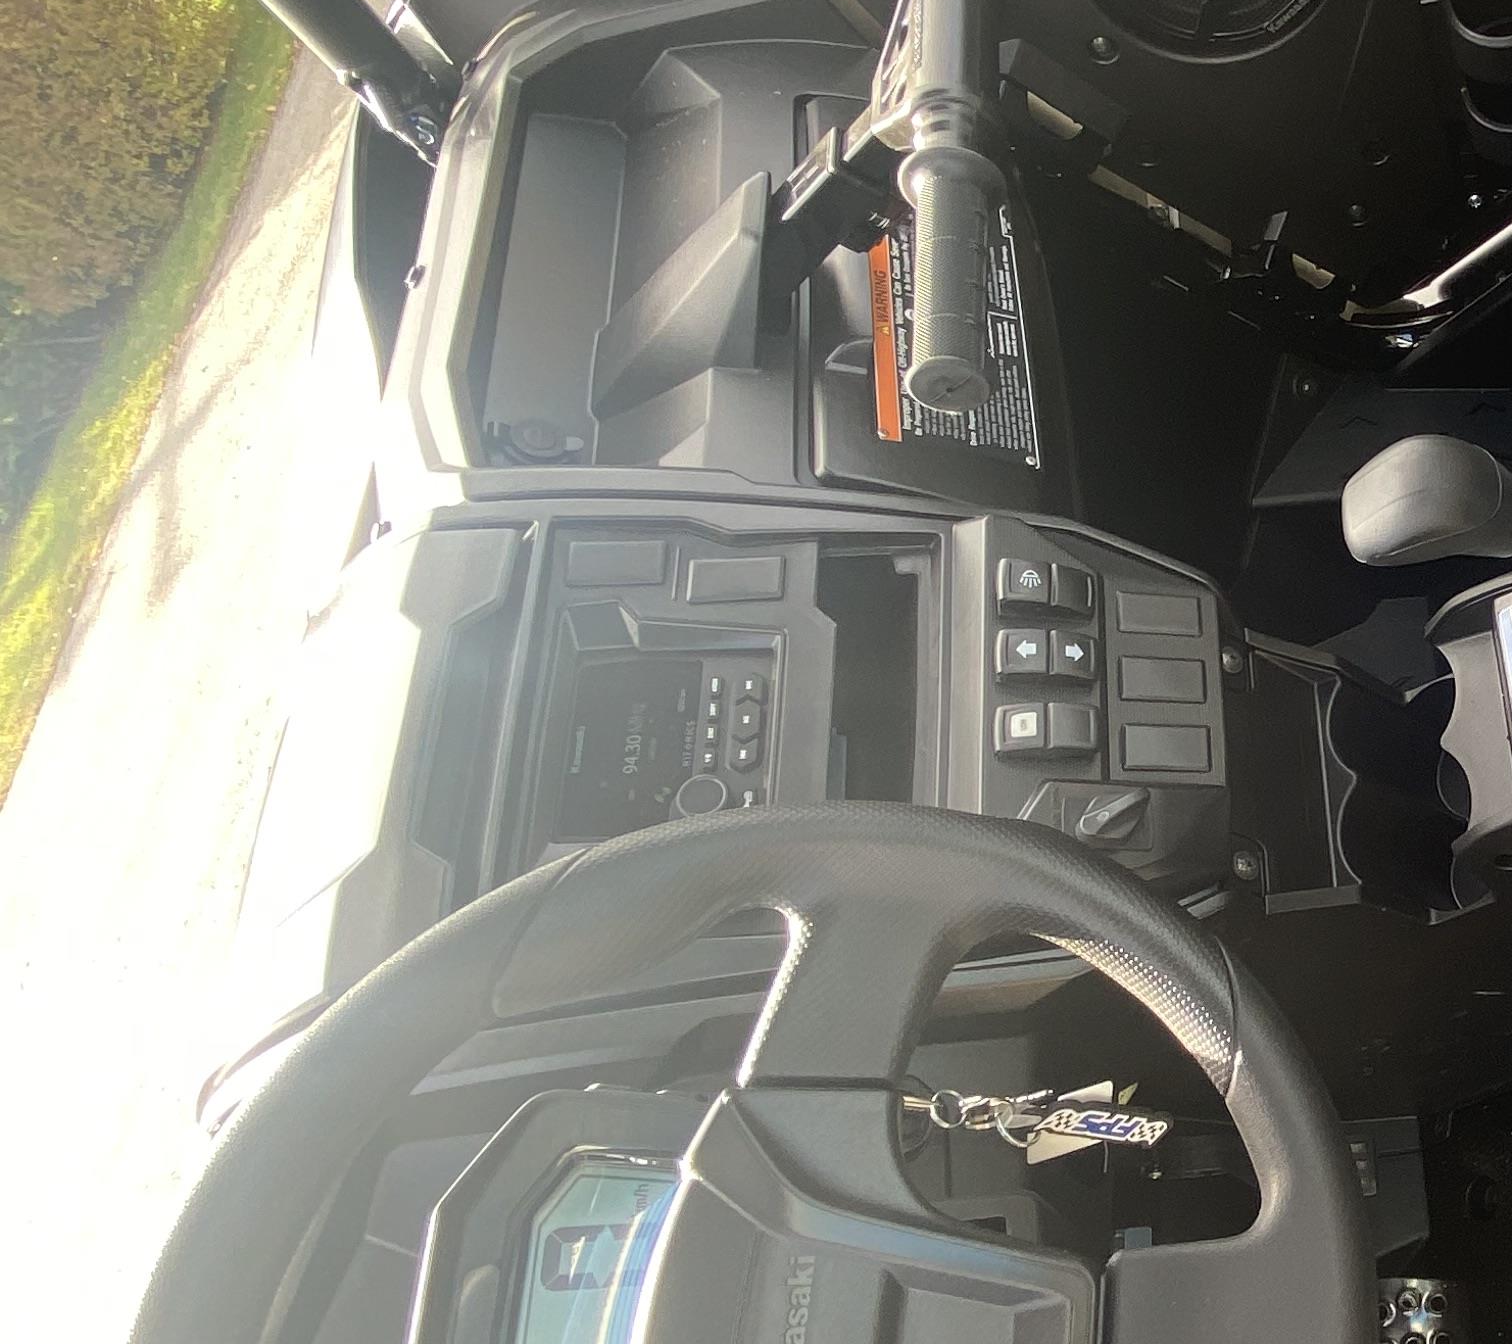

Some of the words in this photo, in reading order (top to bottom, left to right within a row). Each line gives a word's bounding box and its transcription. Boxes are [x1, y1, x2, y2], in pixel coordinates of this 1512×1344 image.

[890, 237, 900, 257] Sever
[891, 258, 901, 279] Cause
[875, 270, 890, 322] WARNING
[893, 281, 902, 295] Can
[894, 297, 903, 324] Vehicles
[897, 326, 909, 368] Off-Highway
[622, 734, 643, 774] 94.30
[1073, 1111, 1140, 1138] FPS
